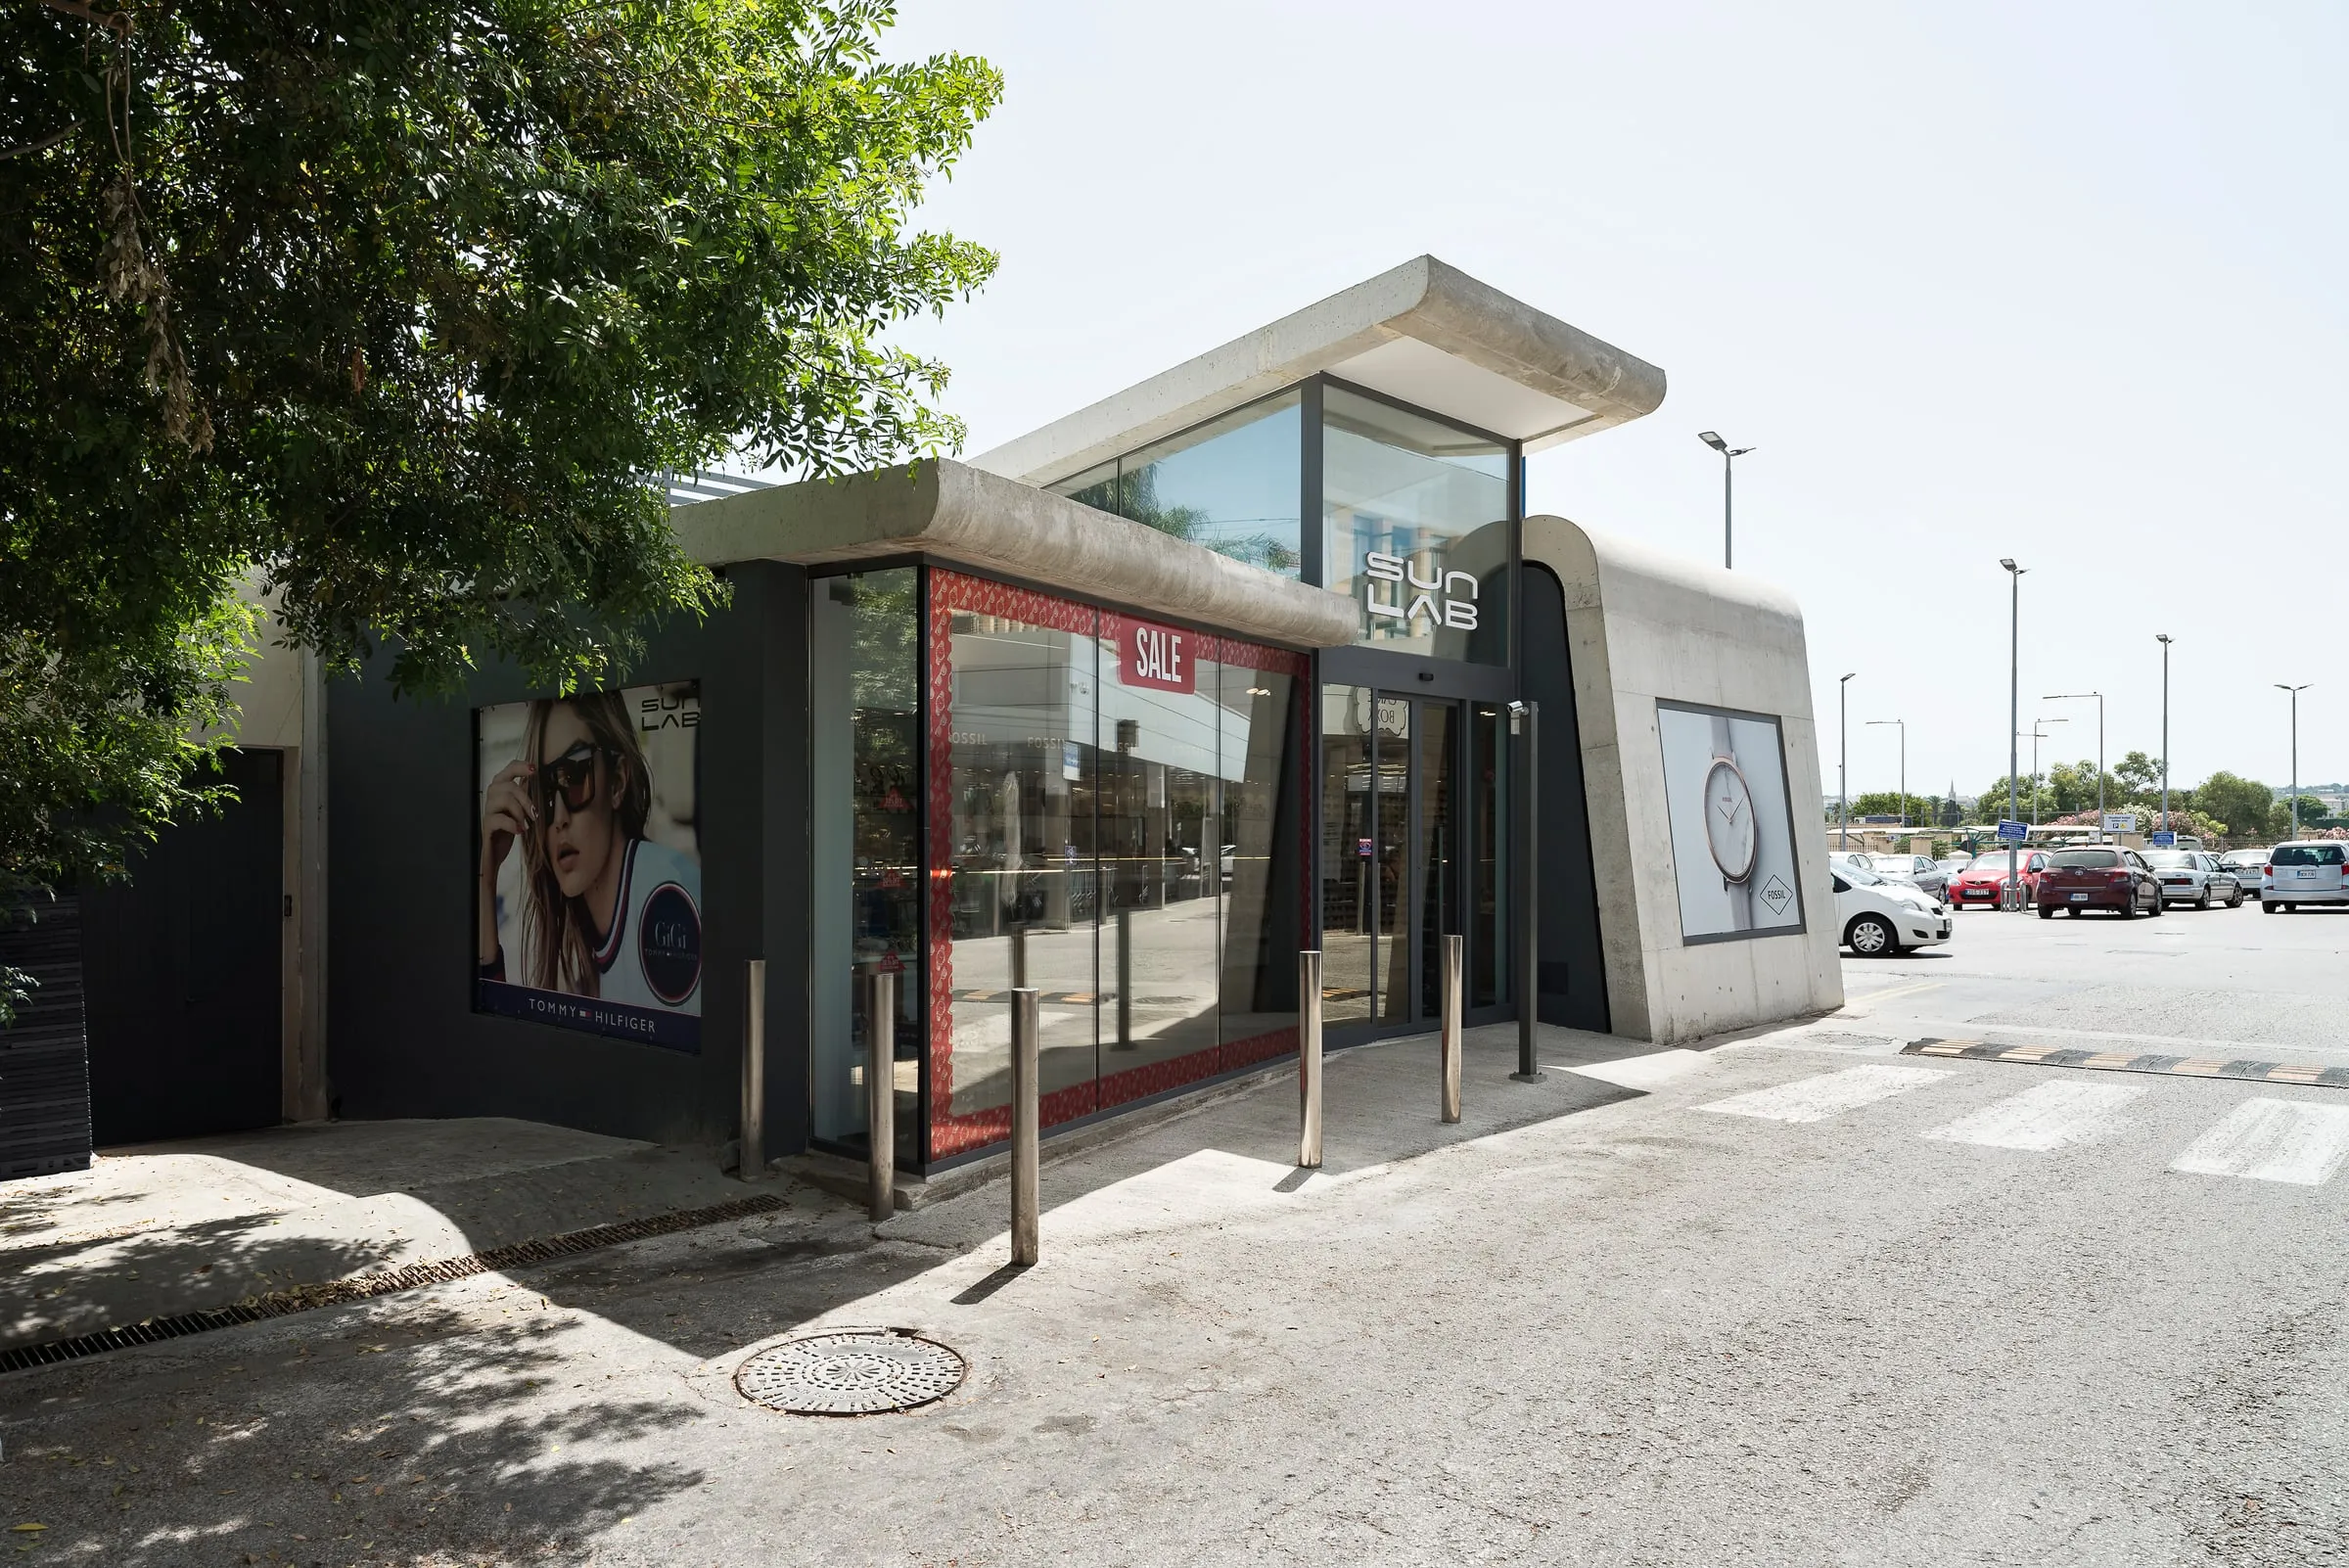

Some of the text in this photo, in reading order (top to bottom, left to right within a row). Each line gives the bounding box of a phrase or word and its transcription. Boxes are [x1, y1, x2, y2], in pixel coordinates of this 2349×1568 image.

[1367, 583, 1479, 630] LAB
[1135, 626, 1182, 683] SALE
[641, 711, 701, 732] LAB
[950, 731, 988, 746] OSSIL
[1768, 890, 1786, 899] FOSSIL
[529, 997, 656, 1034] TOMMY HILFIGER
